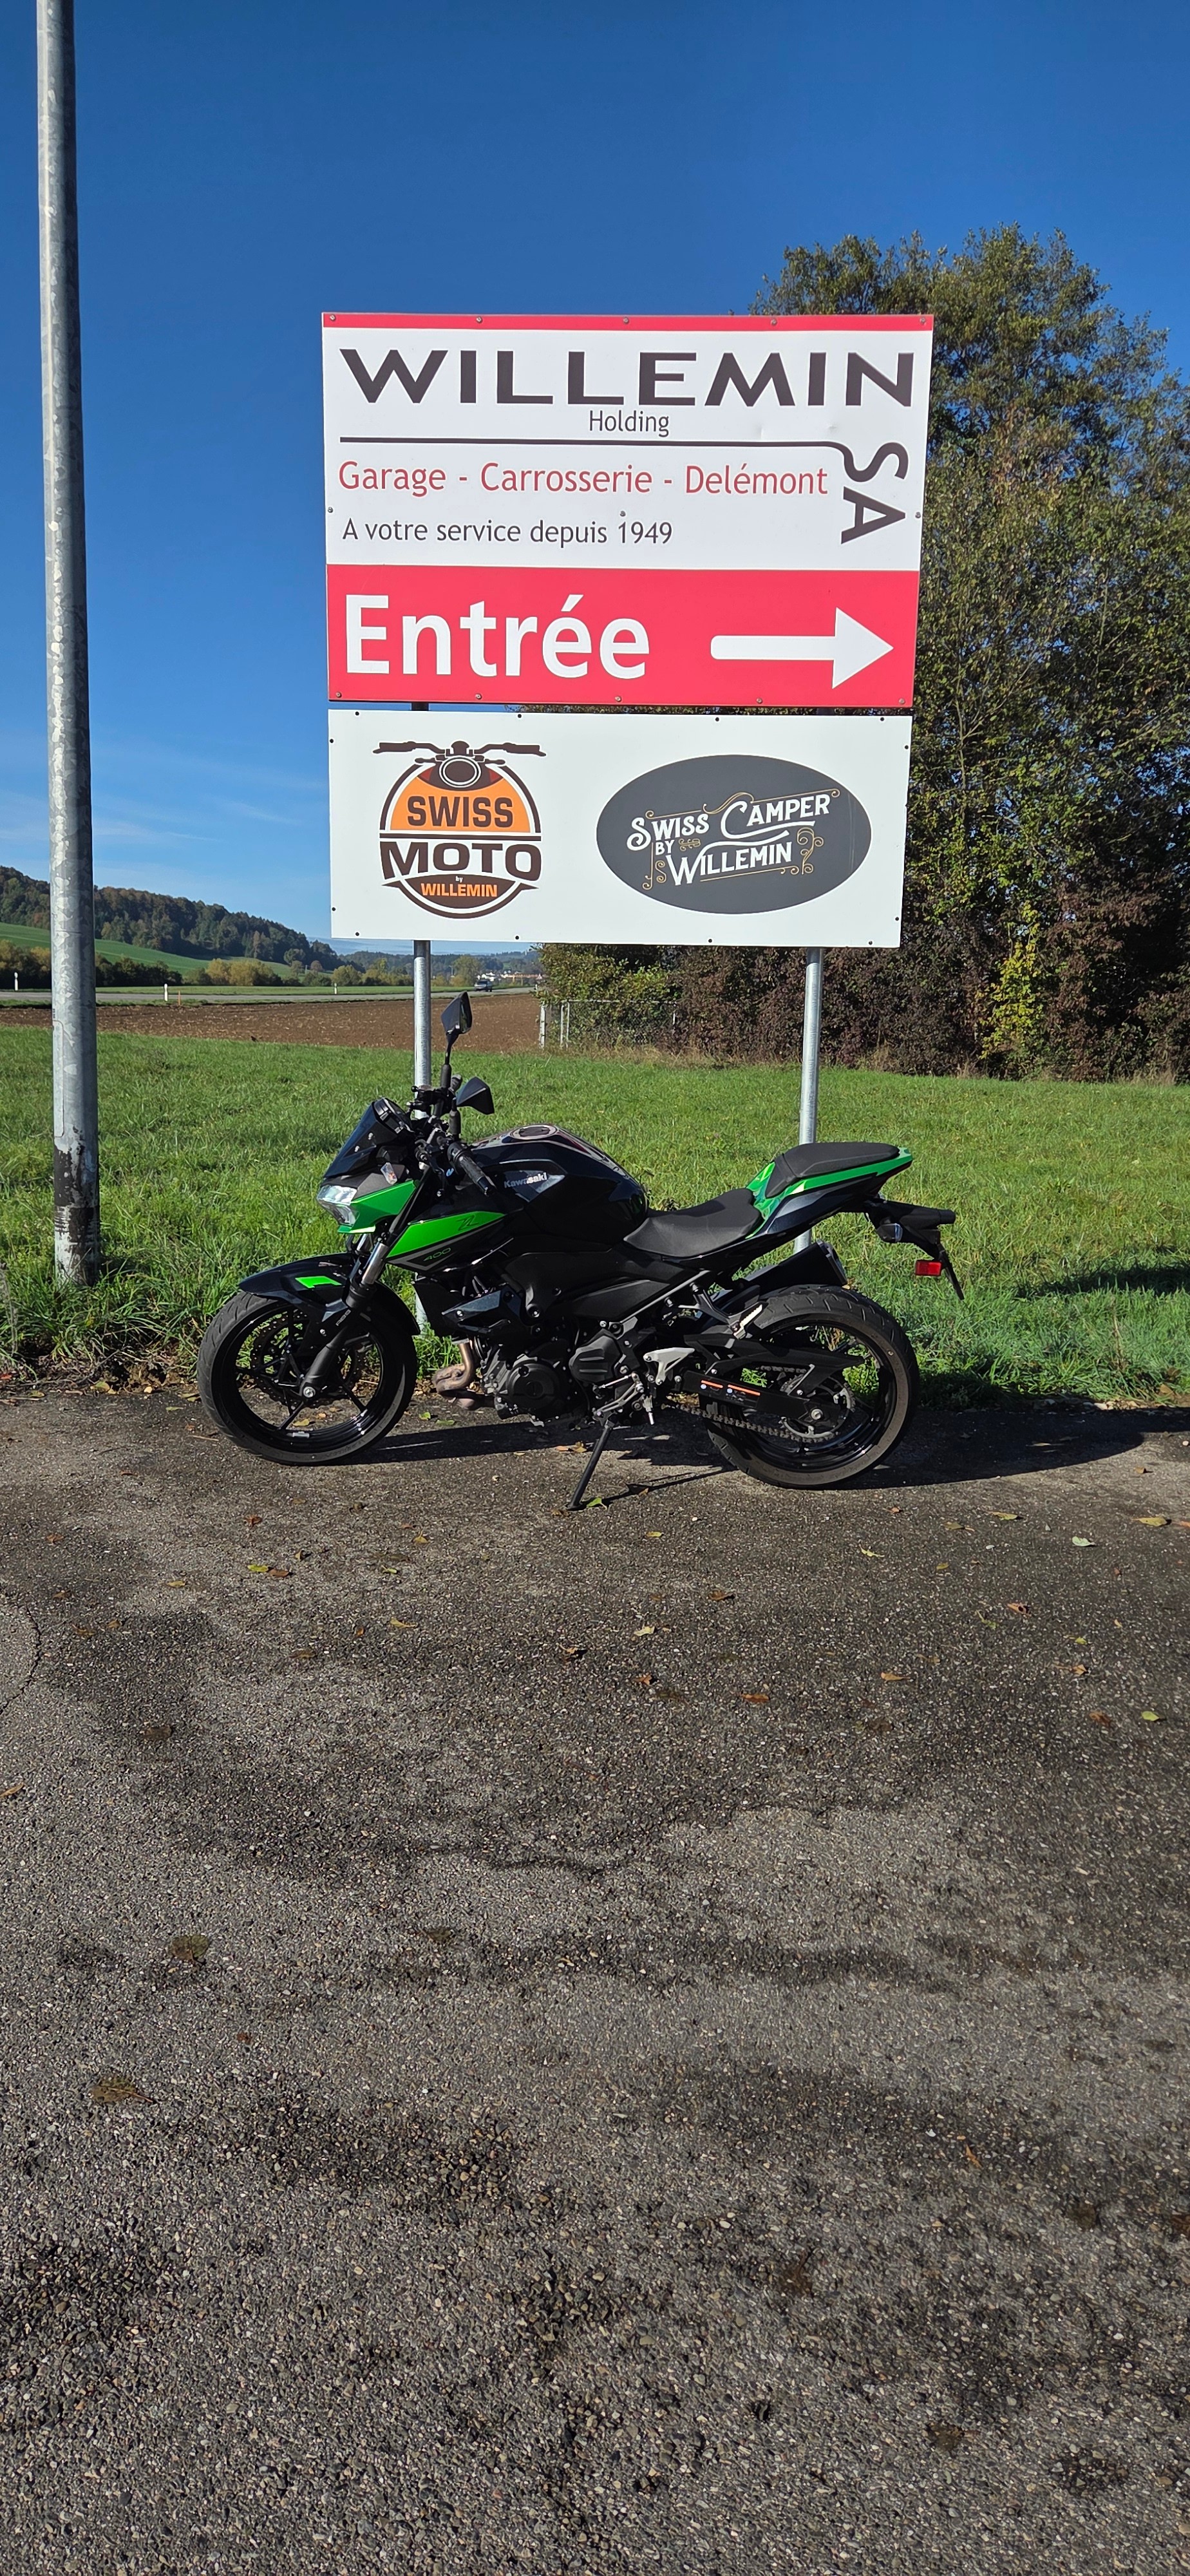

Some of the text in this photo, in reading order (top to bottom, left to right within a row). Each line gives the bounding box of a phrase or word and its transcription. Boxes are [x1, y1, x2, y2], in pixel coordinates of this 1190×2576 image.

[339, 348, 914, 407] WILLEMIN
[589, 410, 670, 438] Holding
[338, 460, 447, 497] Garage
[480, 462, 653, 494] Carrosserie
[685, 462, 829, 495] Delémont
[840, 441, 909, 545] SA
[342, 518, 672, 548] A votre service depuis 1949
[346, 594, 650, 679] Entrée
[407, 795, 513, 828] SWISS
[627, 793, 831, 851] SWISS CAMPER
[379, 841, 542, 882] MOTO
[655, 839, 675, 856] BY
[665, 829, 793, 886] WILLEMIN
[420, 882, 498, 897] WILLEMIN
[423, 1247, 451, 1262] 400
